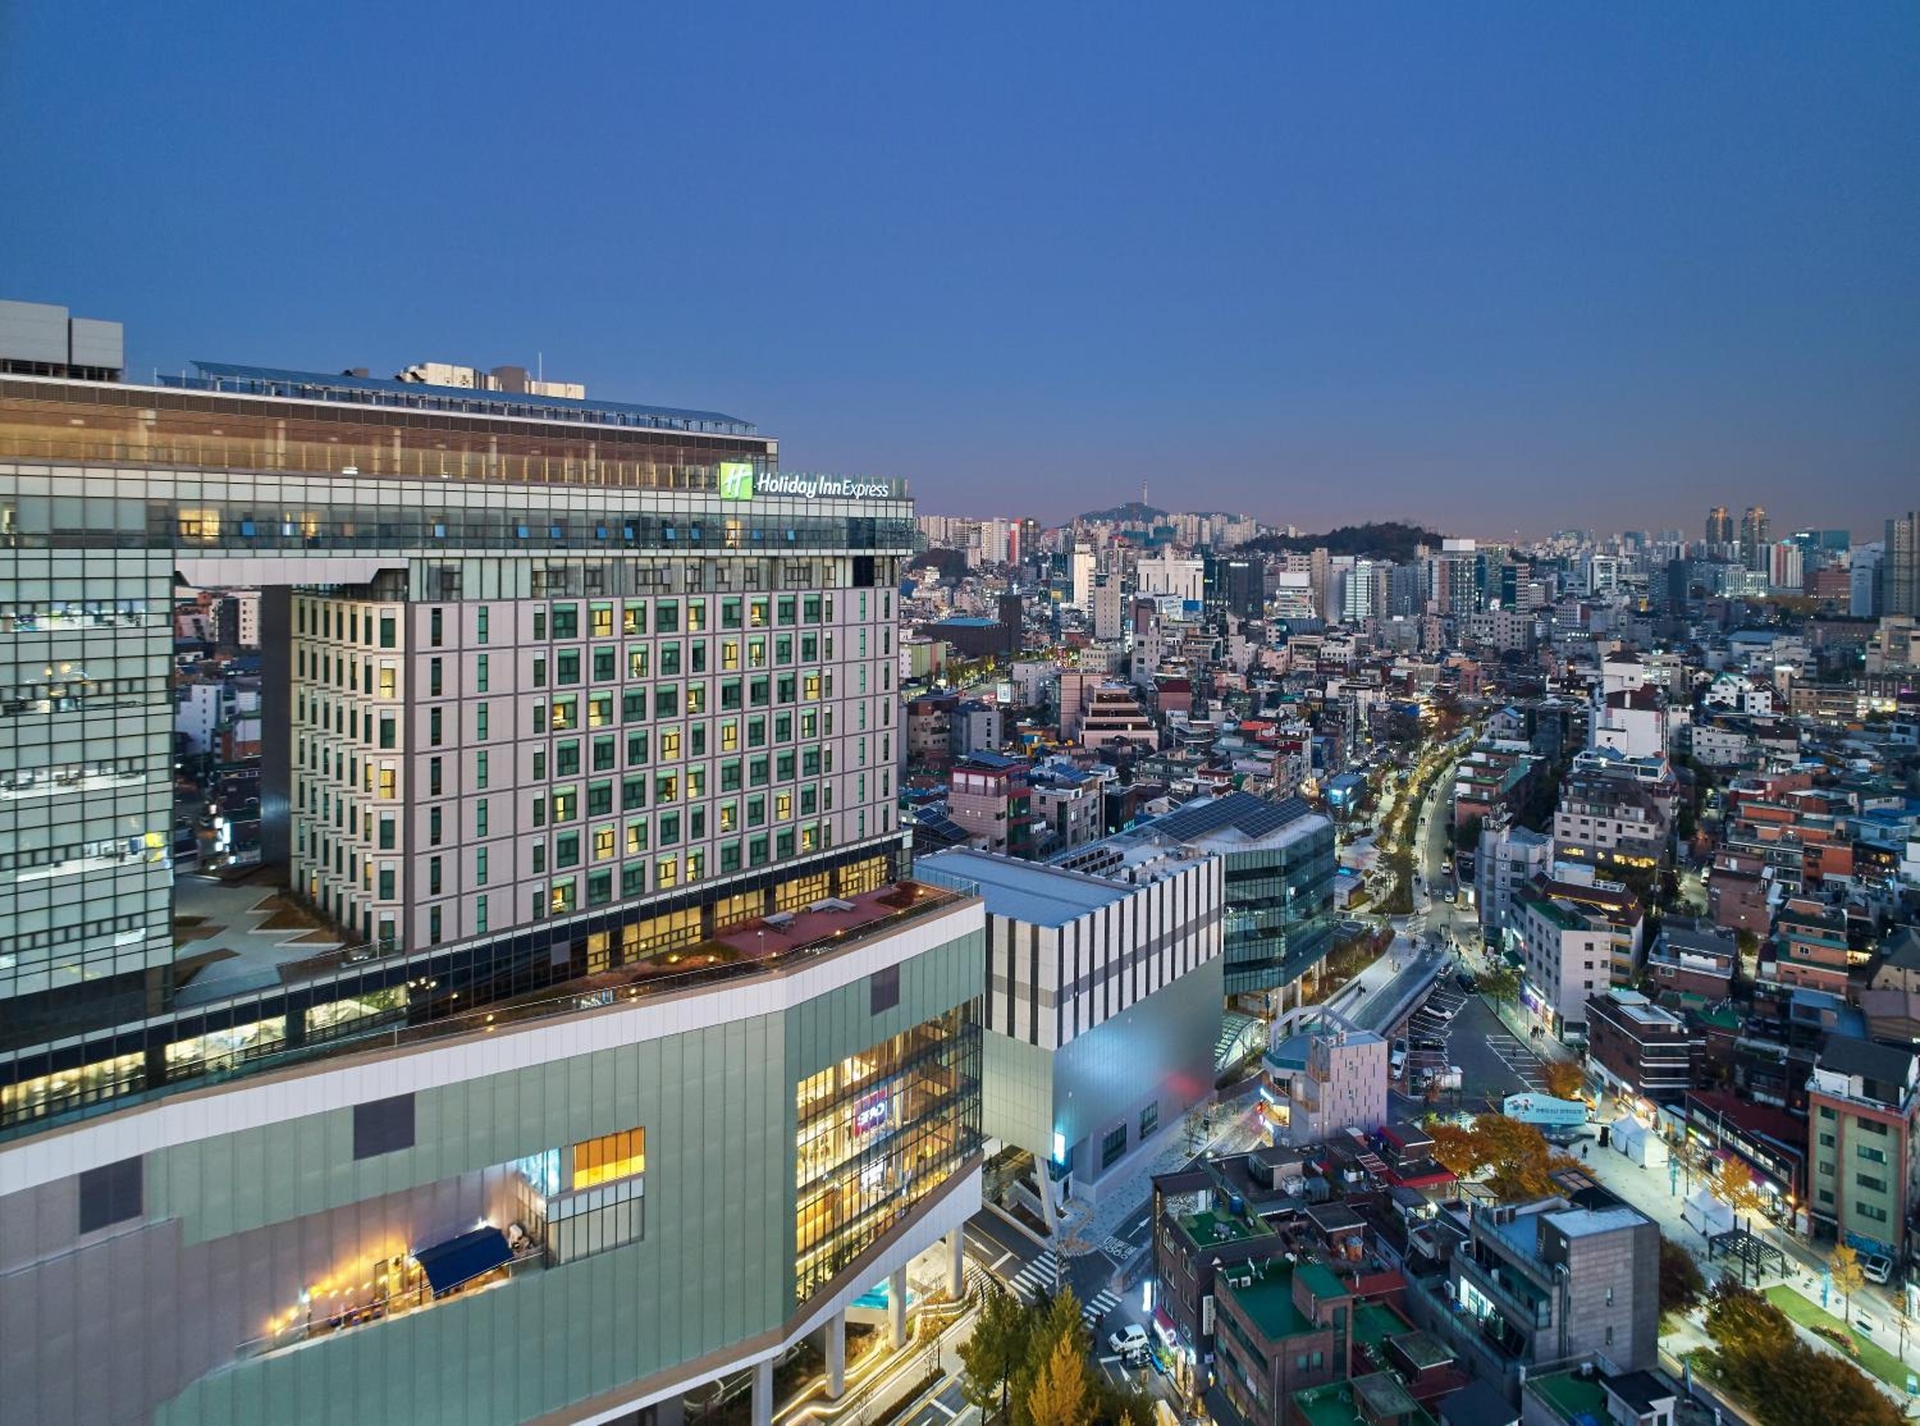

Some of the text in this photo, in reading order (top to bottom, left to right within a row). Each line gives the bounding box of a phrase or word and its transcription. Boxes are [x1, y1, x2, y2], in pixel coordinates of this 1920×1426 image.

[757, 472, 889, 499] Holiday Inn Express
